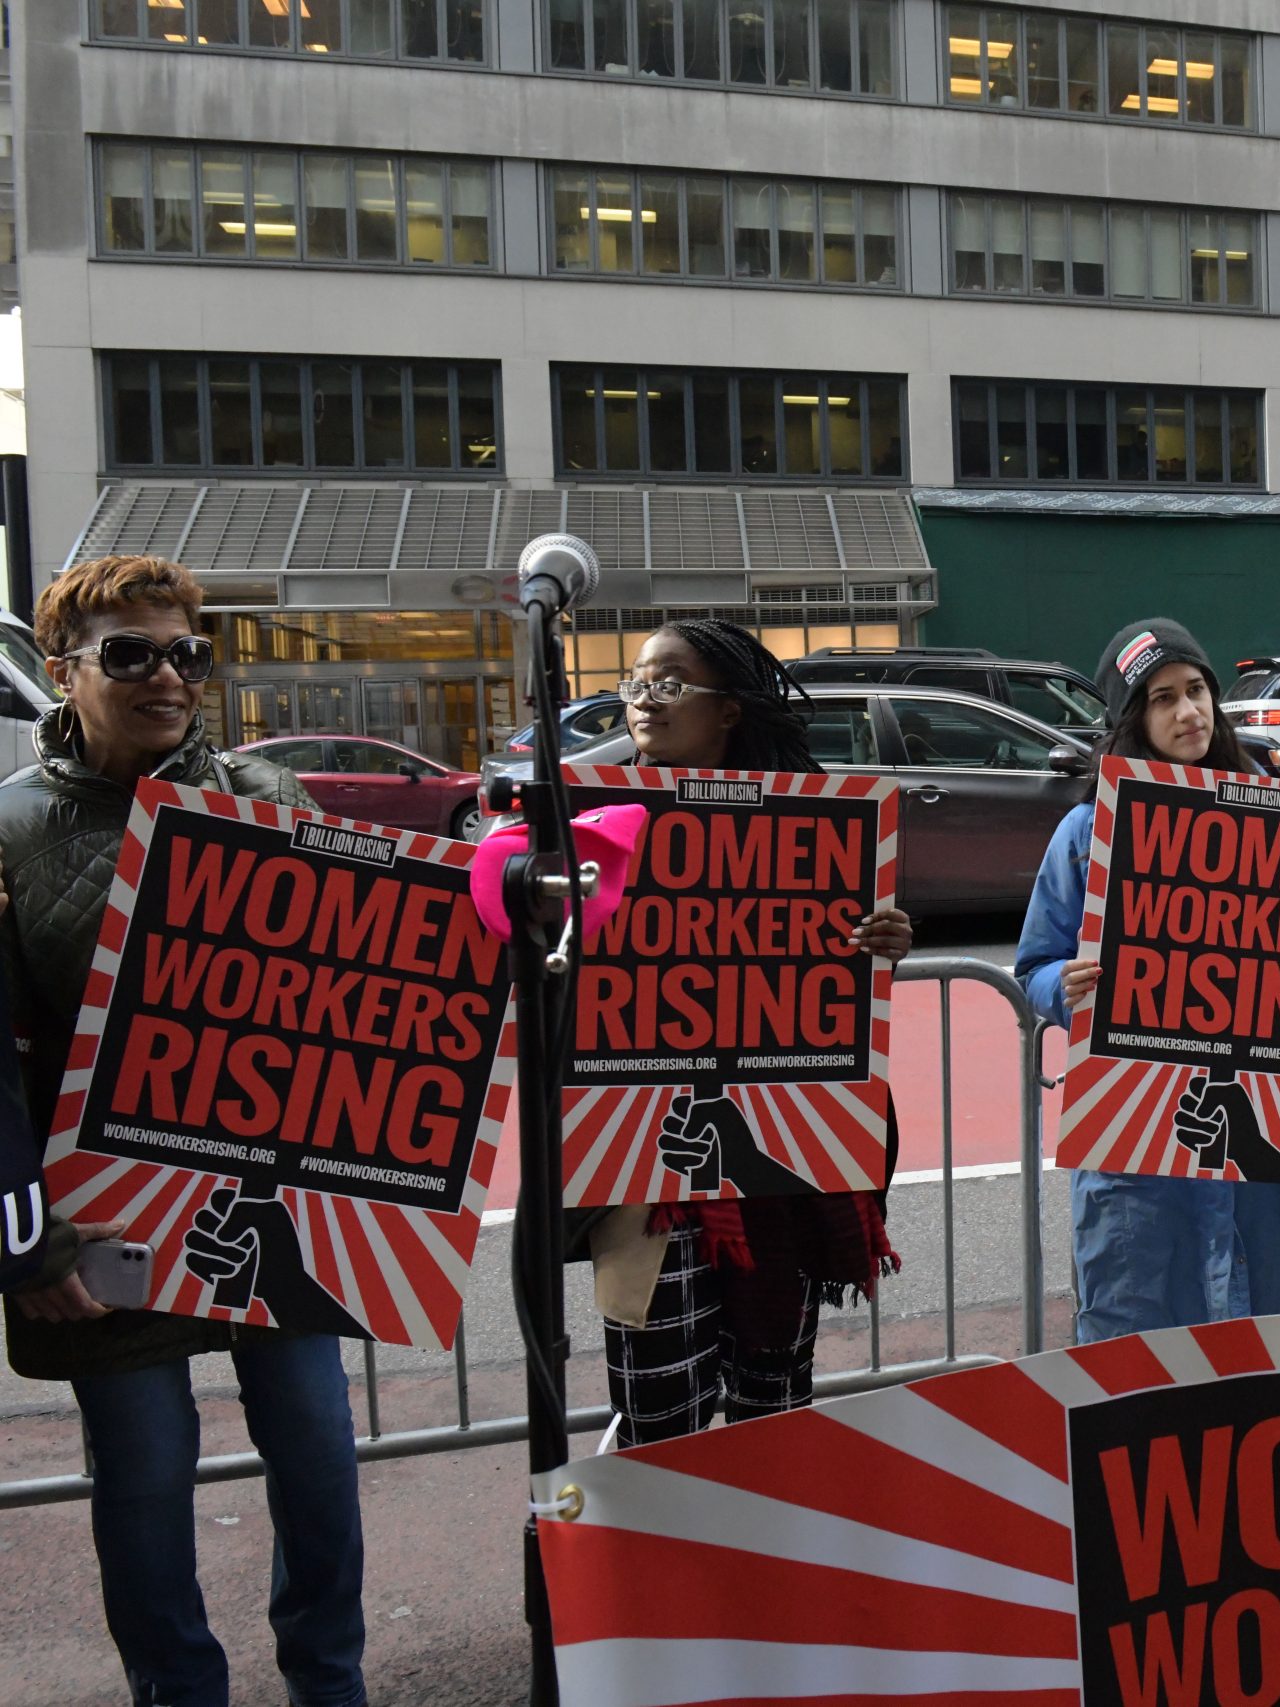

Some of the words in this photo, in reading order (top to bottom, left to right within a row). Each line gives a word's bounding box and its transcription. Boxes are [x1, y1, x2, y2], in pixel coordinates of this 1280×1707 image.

[165, 835, 501, 986] WOMEN
[142, 934, 489, 1062] WORKERS
[575, 963, 856, 1051] RISING
[573, 1056, 717, 1073] WOMENWORKERSRISING.ORG
[737, 1053, 855, 1069] #WOMENWORKERSRISING
[1107, 1032, 1232, 1056] WOMENWORKERSRISING.ORG
[110, 1013, 464, 1167] RISING
[103, 1122, 276, 1165] WOMENWORKERSRISING.ORG
[299, 1155, 446, 1192] #WOMENWORKERSRISING
